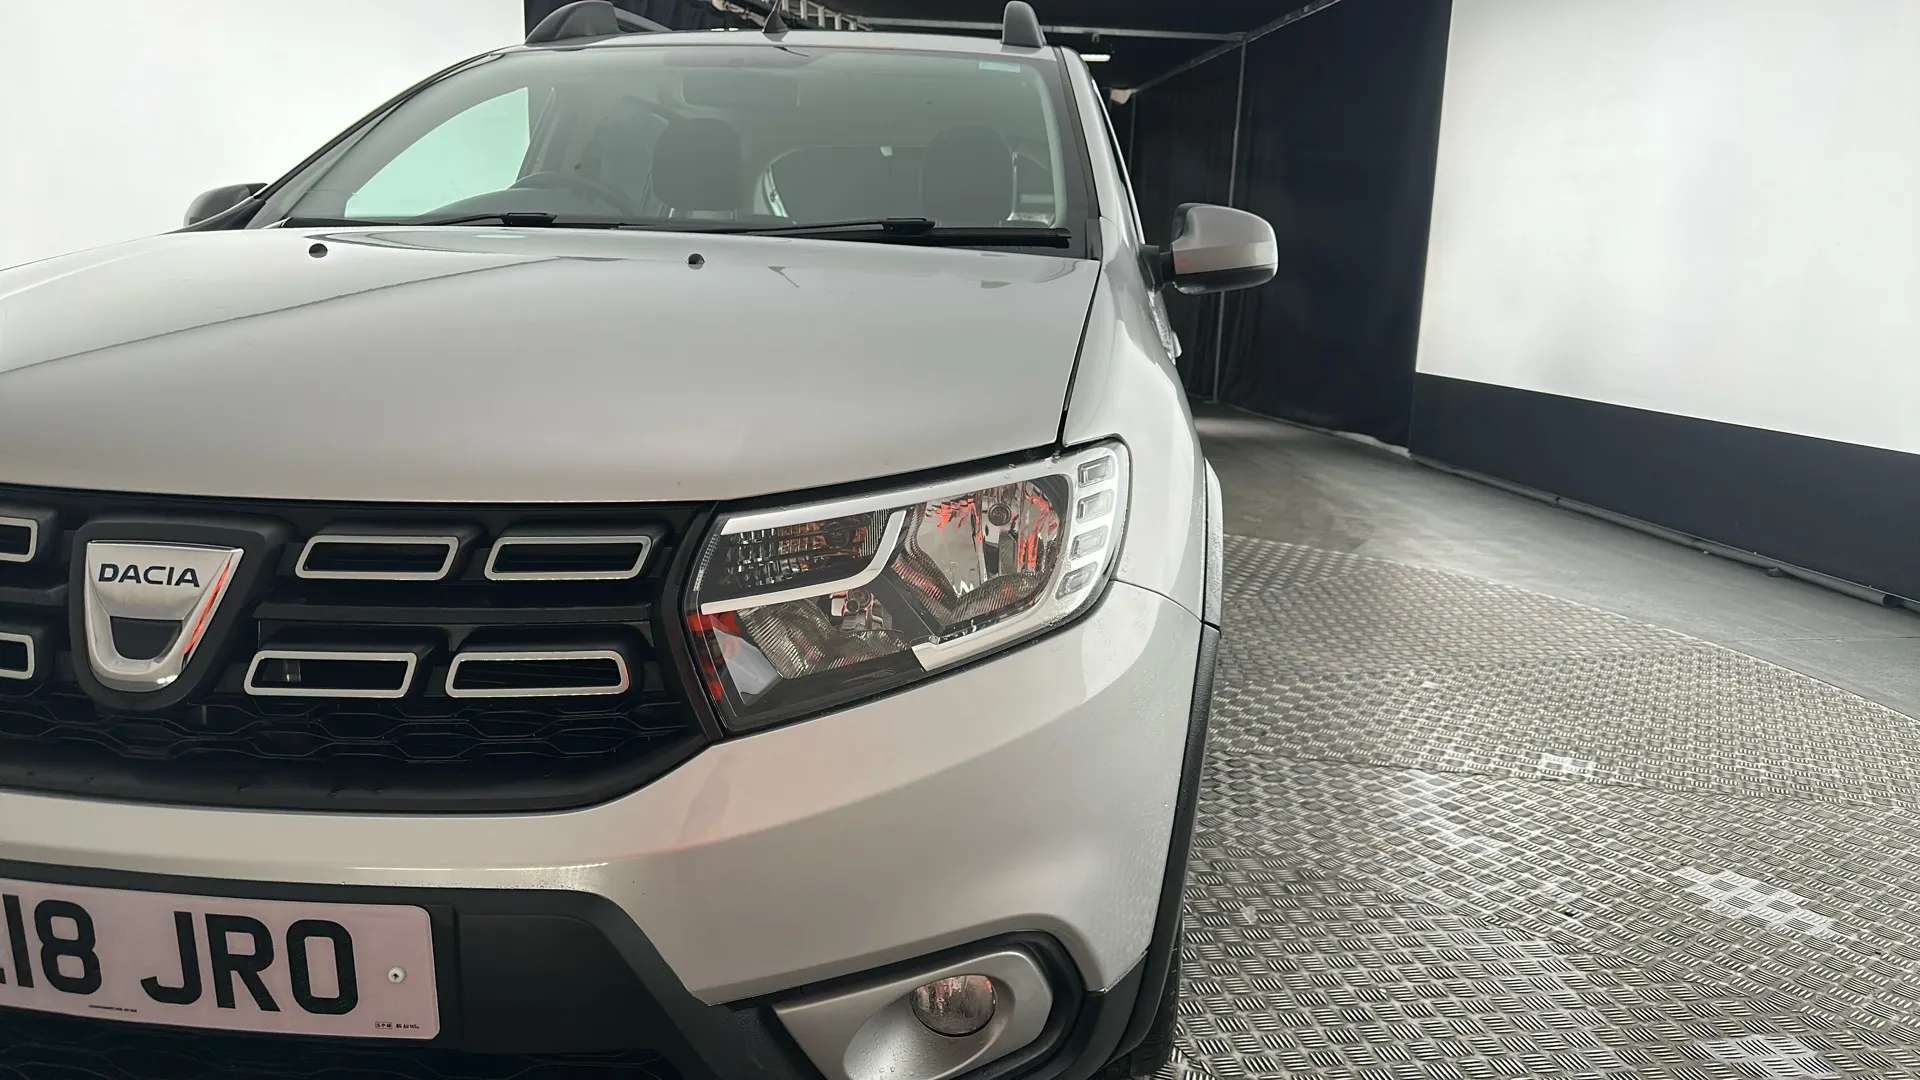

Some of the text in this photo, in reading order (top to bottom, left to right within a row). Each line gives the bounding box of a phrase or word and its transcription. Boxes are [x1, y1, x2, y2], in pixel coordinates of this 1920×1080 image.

[98, 563, 200, 588] DACIA
[0, 893, 359, 1015] 18 JRO
